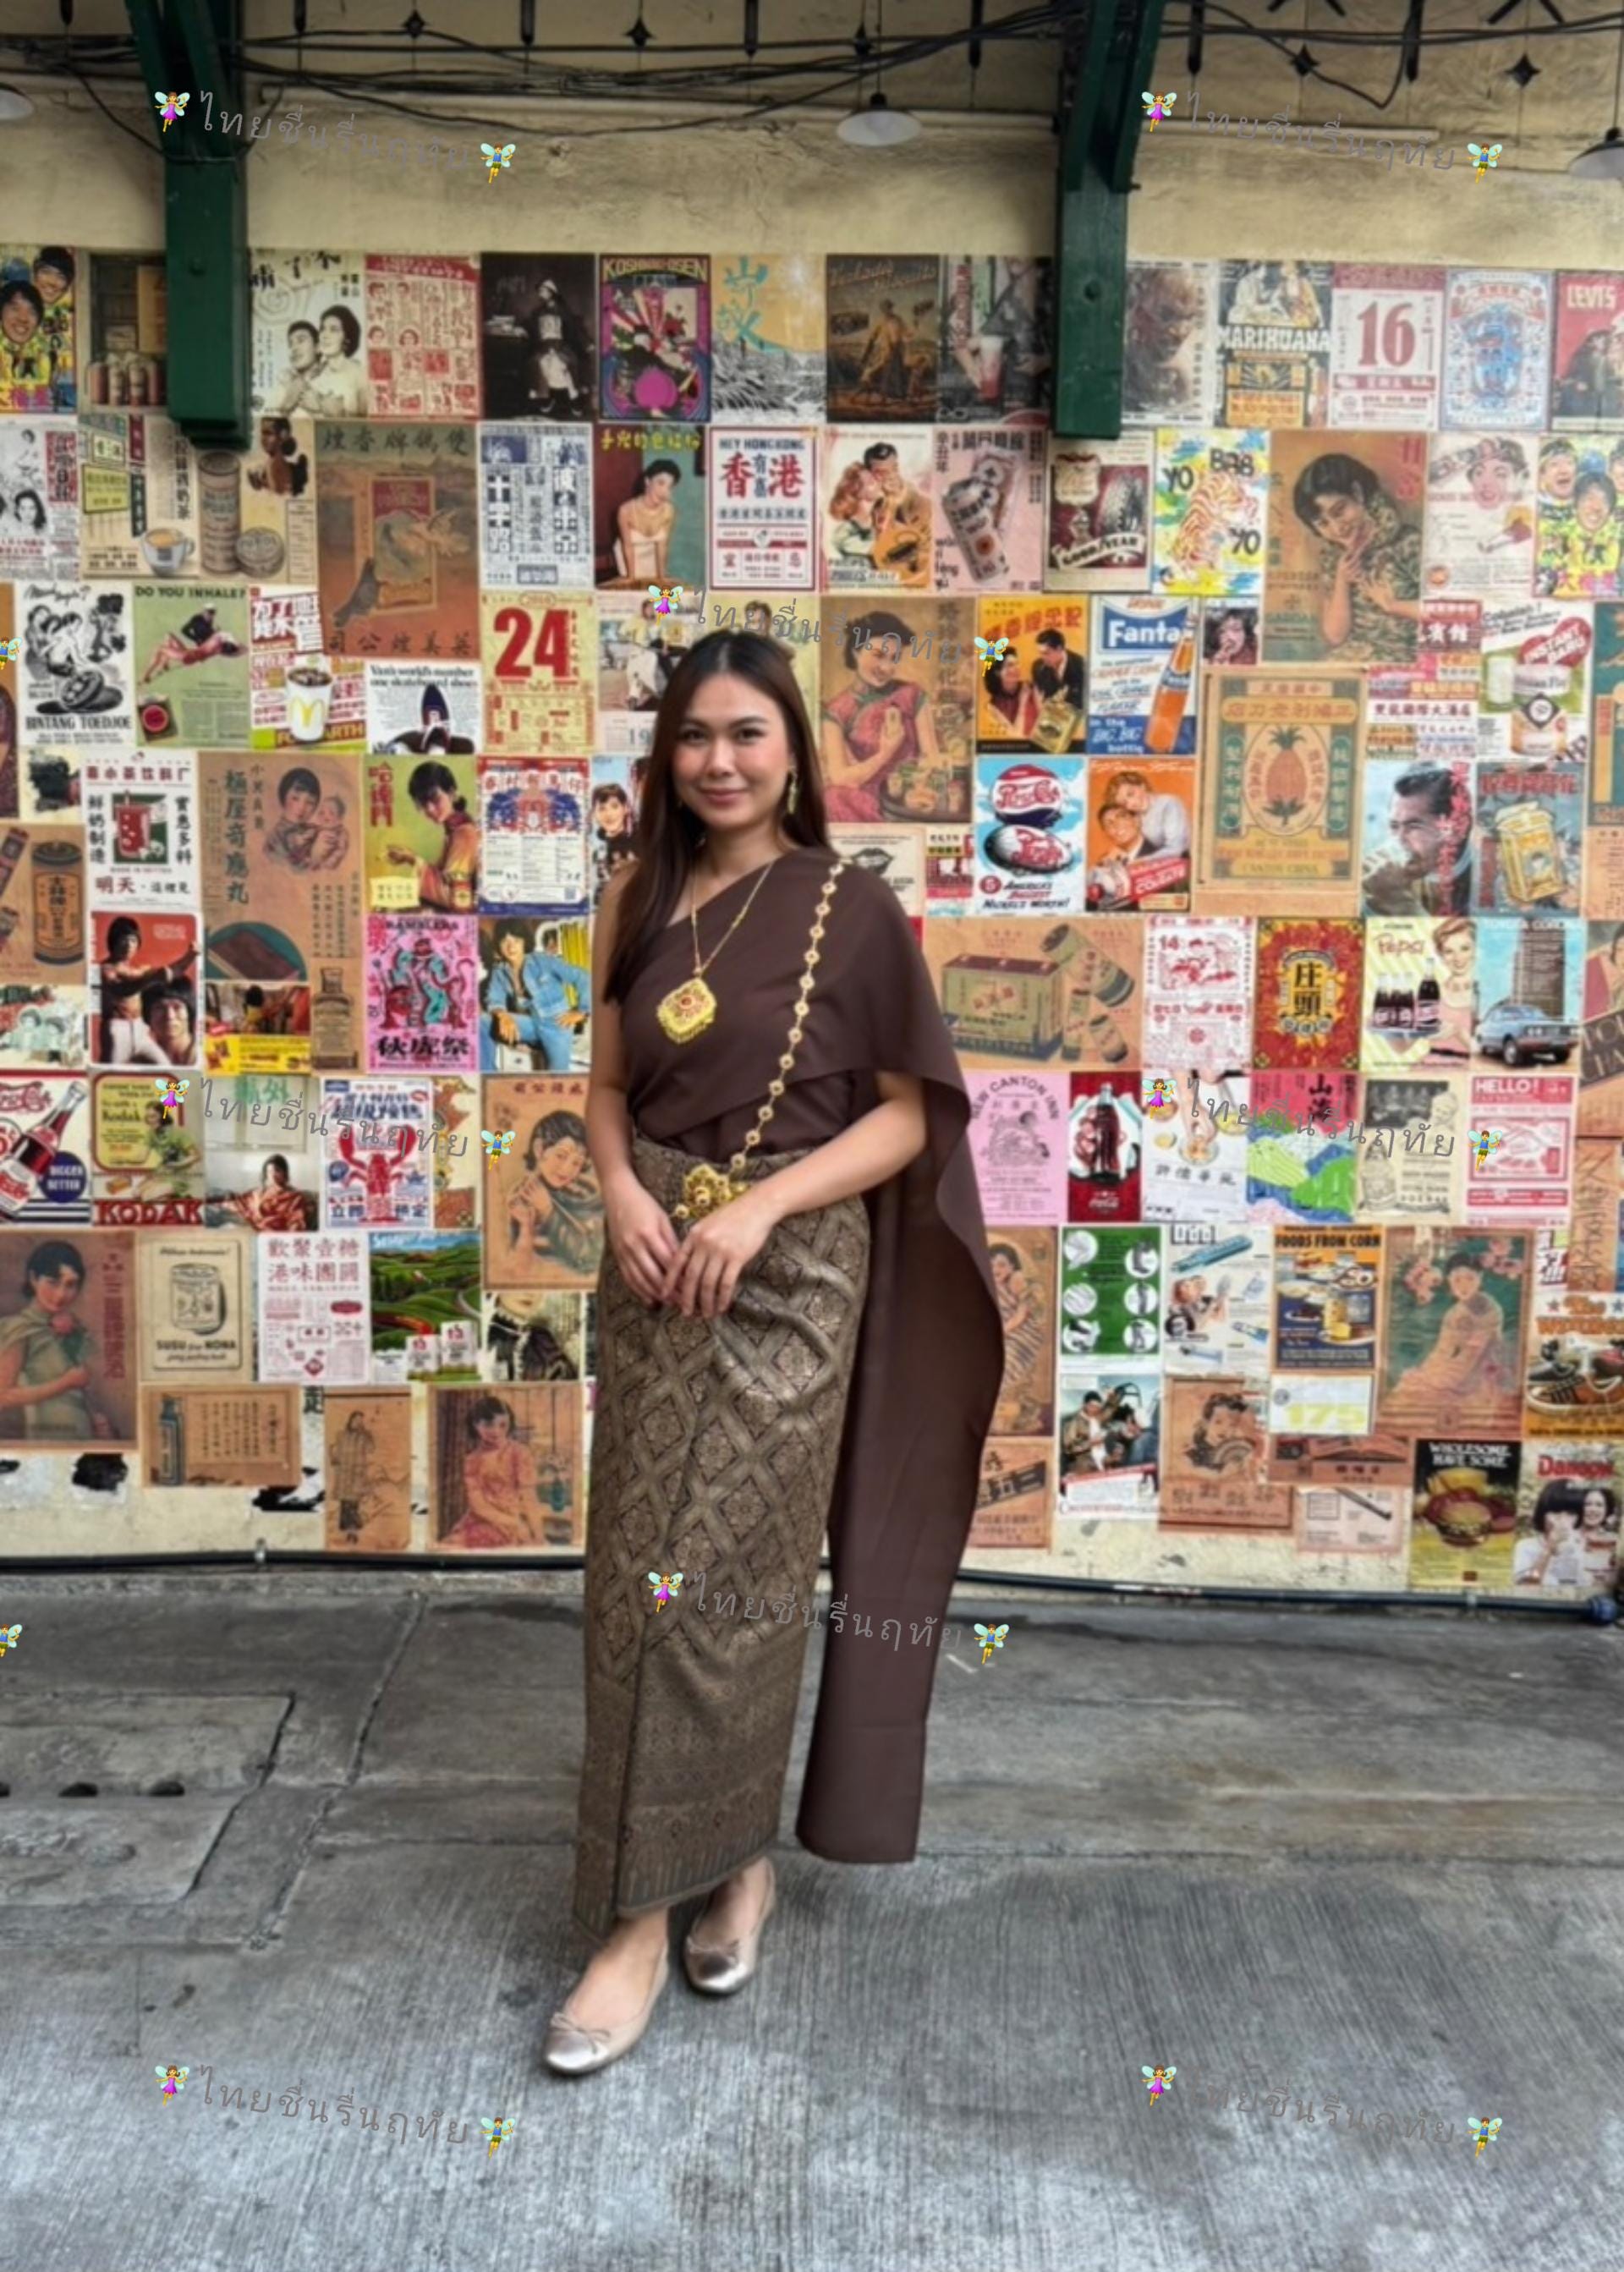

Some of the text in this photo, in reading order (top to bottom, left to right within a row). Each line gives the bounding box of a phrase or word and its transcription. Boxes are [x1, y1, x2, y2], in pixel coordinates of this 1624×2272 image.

[1217, 326, 1331, 353] MARIHUANA
[1357, 301, 1416, 367] 16
[719, 438, 743, 450] HEY
[1162, 465, 1194, 493] YO
[1229, 526, 1262, 557] YO
[135, 586, 246, 599] DO YOU INHALE?
[493, 606, 570, 678] 24
[1107, 618, 1182, 650] Fanta
[96, 875, 137, 895] 明天
[1158, 935, 1179, 951] 14
[990, 1076, 1047, 1095] CANTON
[1475, 1078, 1539, 1094] HELLO!
[98, 1202, 203, 1226] KODAK
[1275, 1234, 1381, 1249] FOODS FROM CORN
[1432, 1454, 1464, 1467] HAVE
